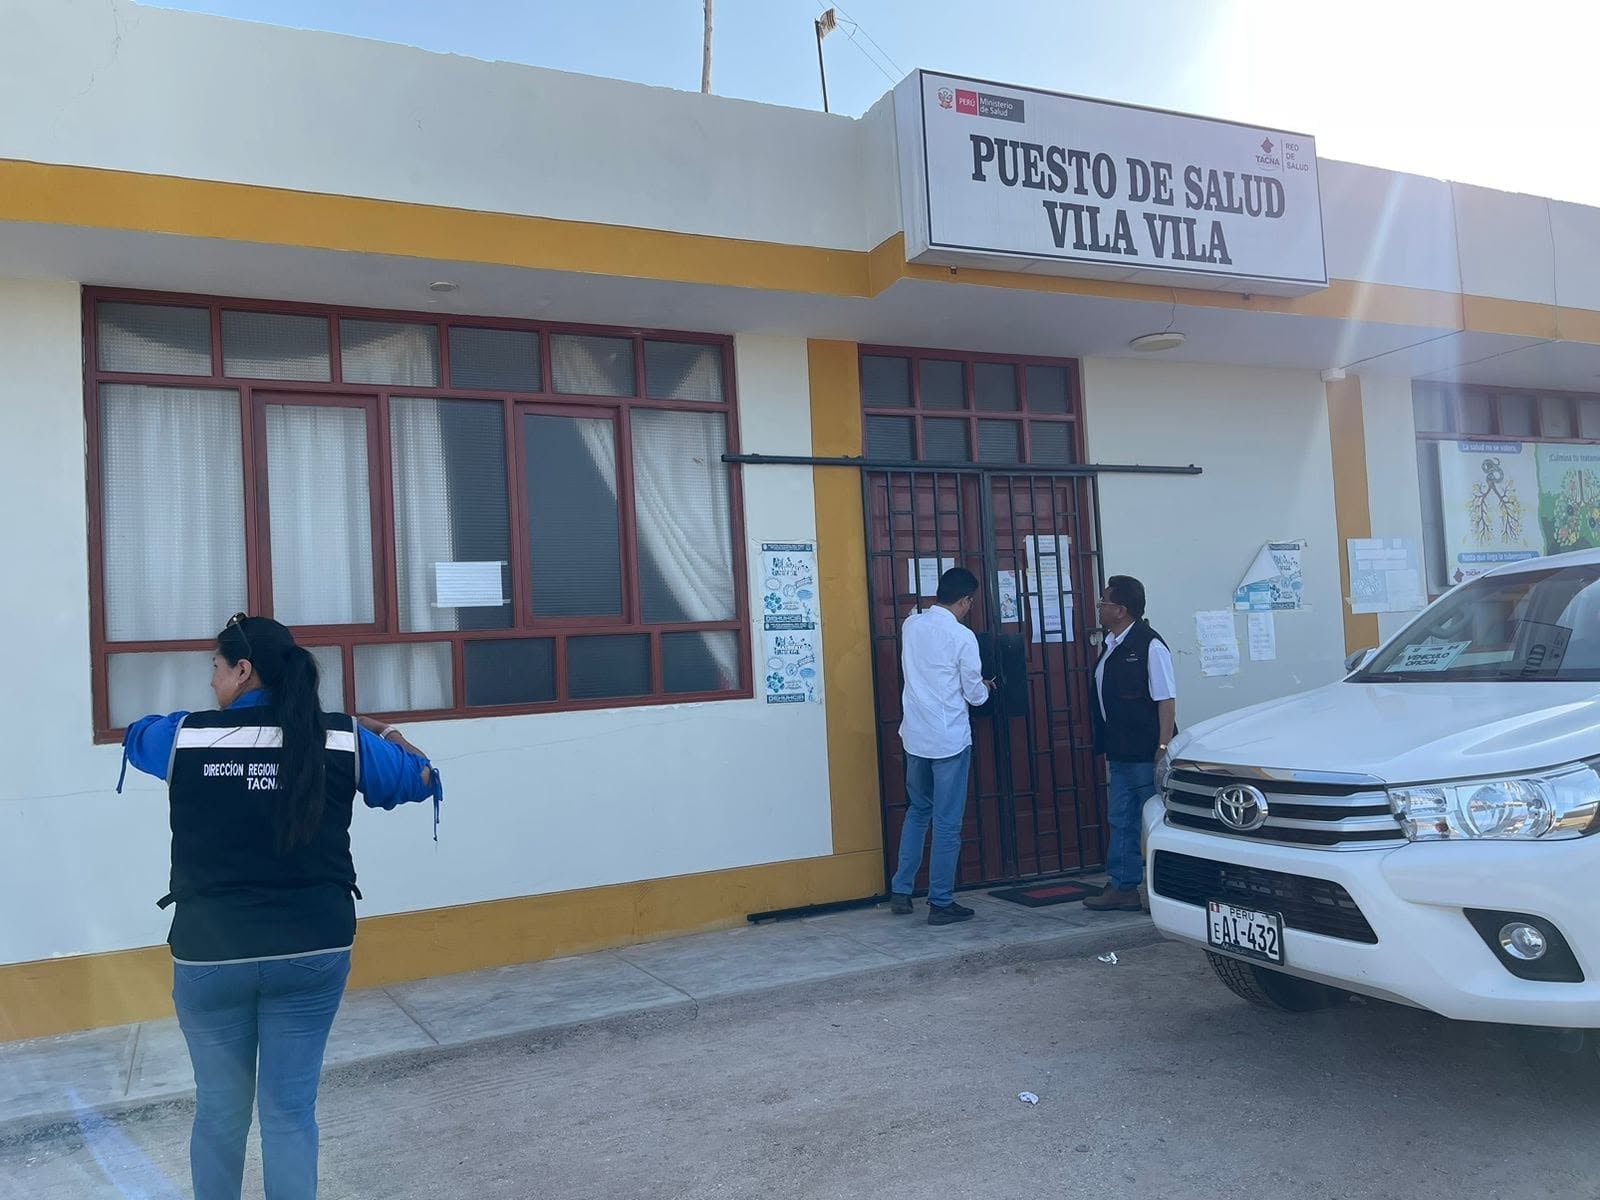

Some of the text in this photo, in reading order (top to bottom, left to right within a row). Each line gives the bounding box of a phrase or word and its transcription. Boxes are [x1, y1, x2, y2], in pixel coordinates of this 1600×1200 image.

[979, 97, 1014, 110] Ministerio
[979, 105, 1008, 117] de Salud
[1285, 142, 1299, 152] RED
[1255, 154, 1280, 166] TACNA
[1285, 152, 1296, 161] DE
[1286, 161, 1309, 172] SALUD
[969, 133, 1286, 219] PUESTO DE SALUD
[1042, 200, 1233, 265] VILA VILA
[1229, 907, 1255, 922] PERU
